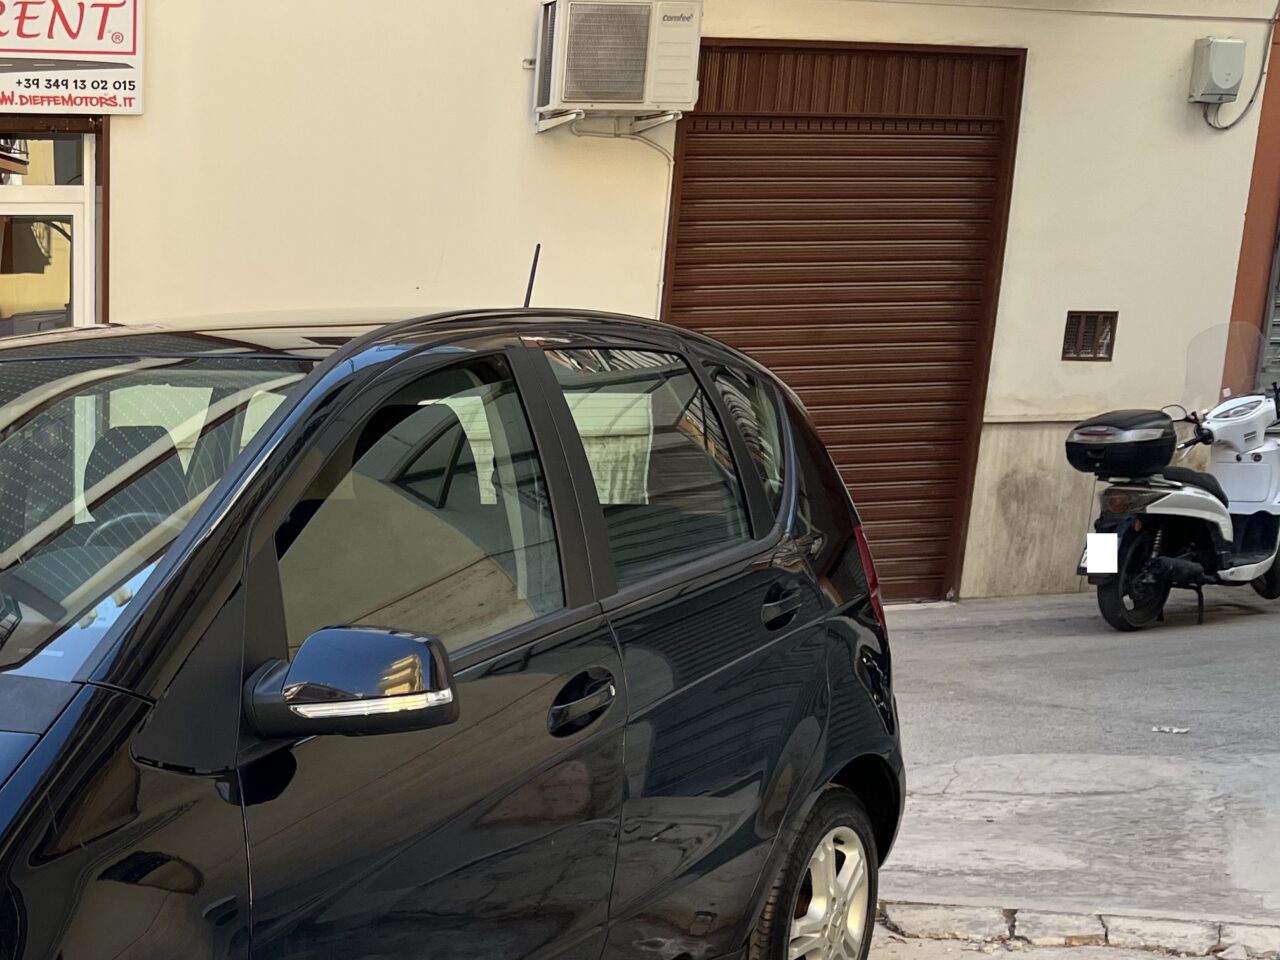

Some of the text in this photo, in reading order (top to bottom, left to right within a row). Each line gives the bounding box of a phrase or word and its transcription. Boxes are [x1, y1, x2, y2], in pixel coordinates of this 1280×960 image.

[16, 78, 136, 91] +39 349 13 02 015
